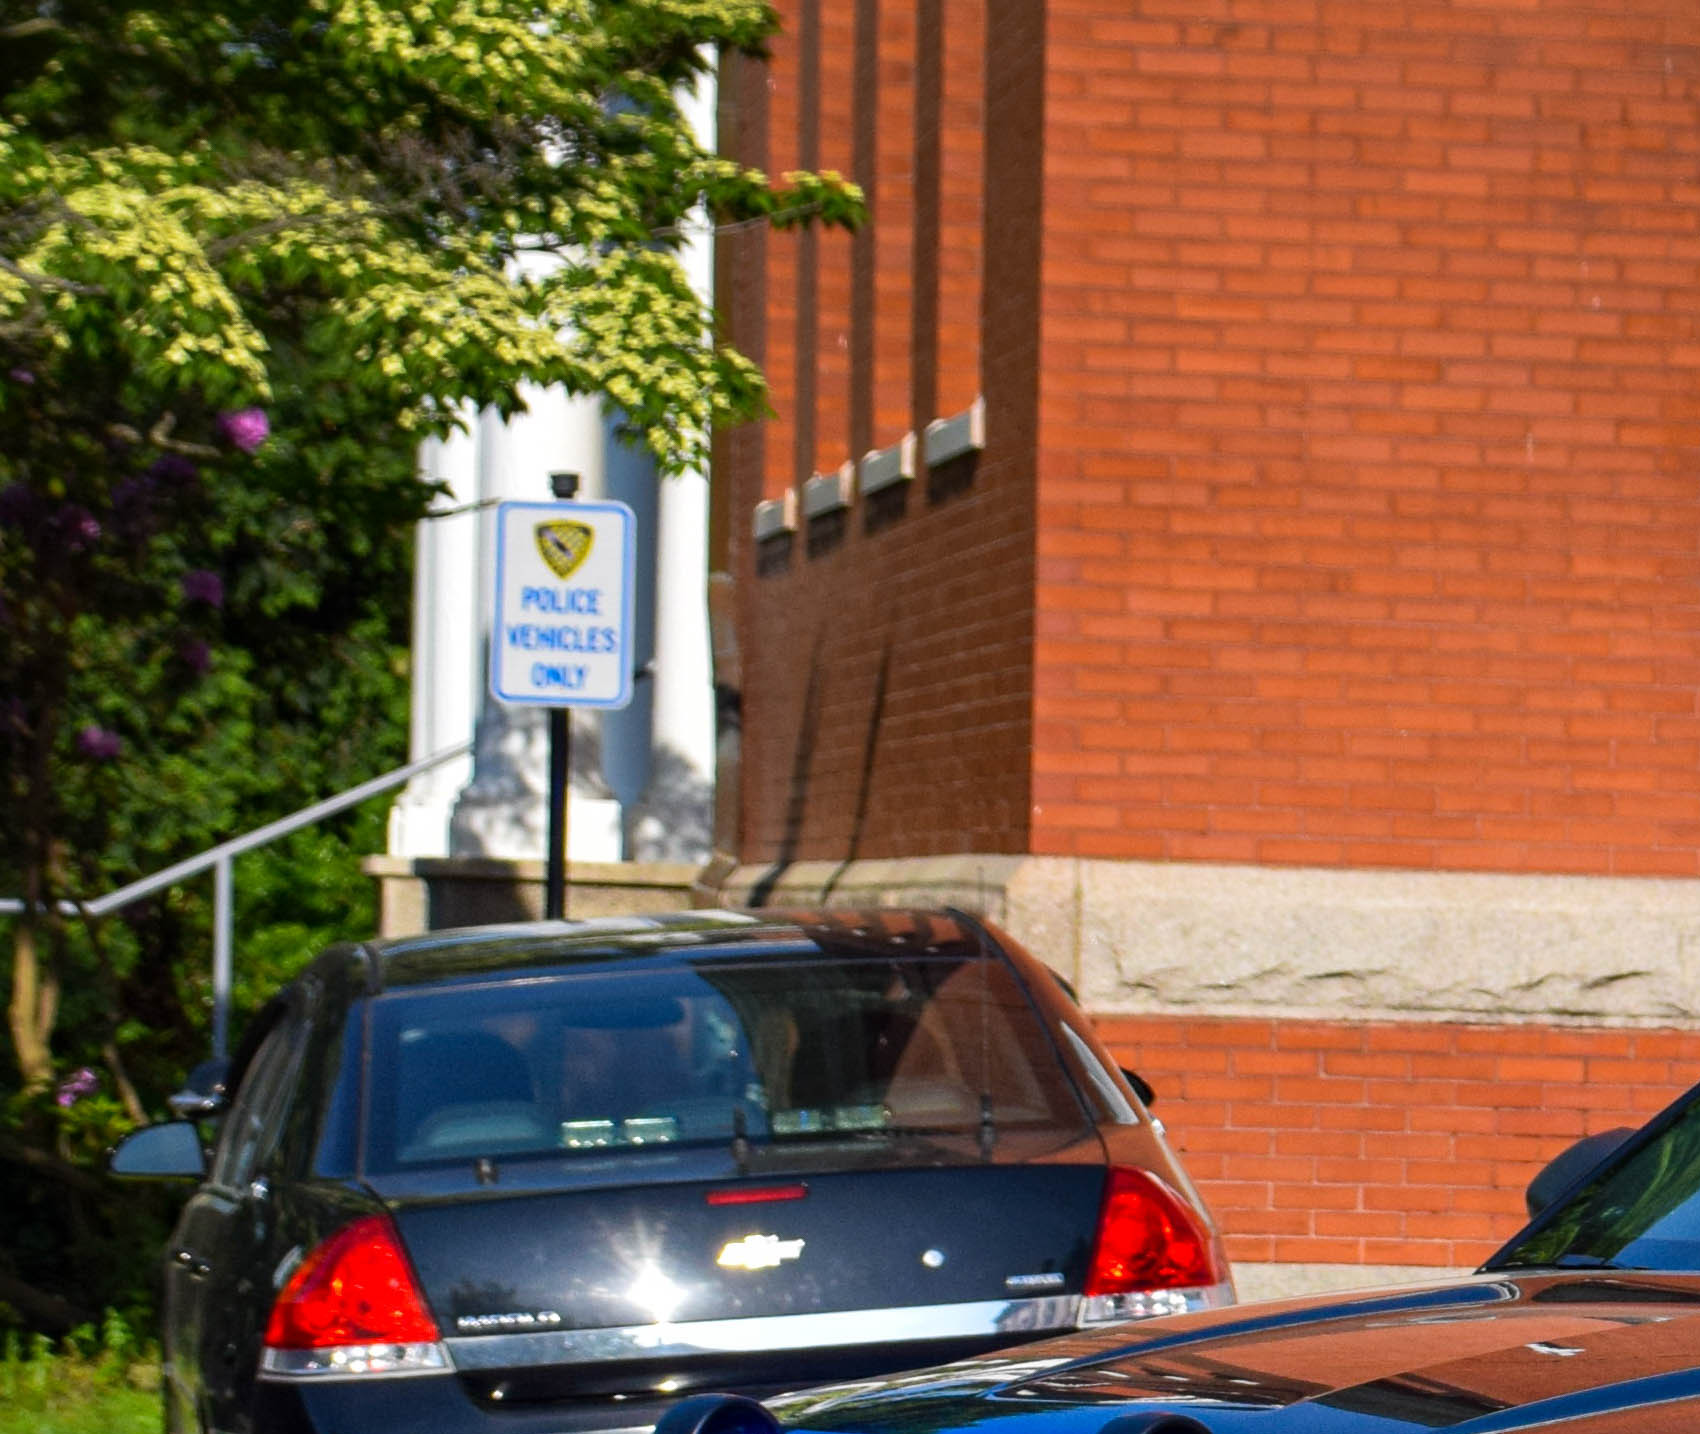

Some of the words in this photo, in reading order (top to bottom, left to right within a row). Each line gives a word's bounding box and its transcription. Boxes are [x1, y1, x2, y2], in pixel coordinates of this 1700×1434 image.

[521, 586, 601, 615] POLICE
[507, 626, 617, 651] VEHICLES
[531, 663, 588, 688] ONLY
